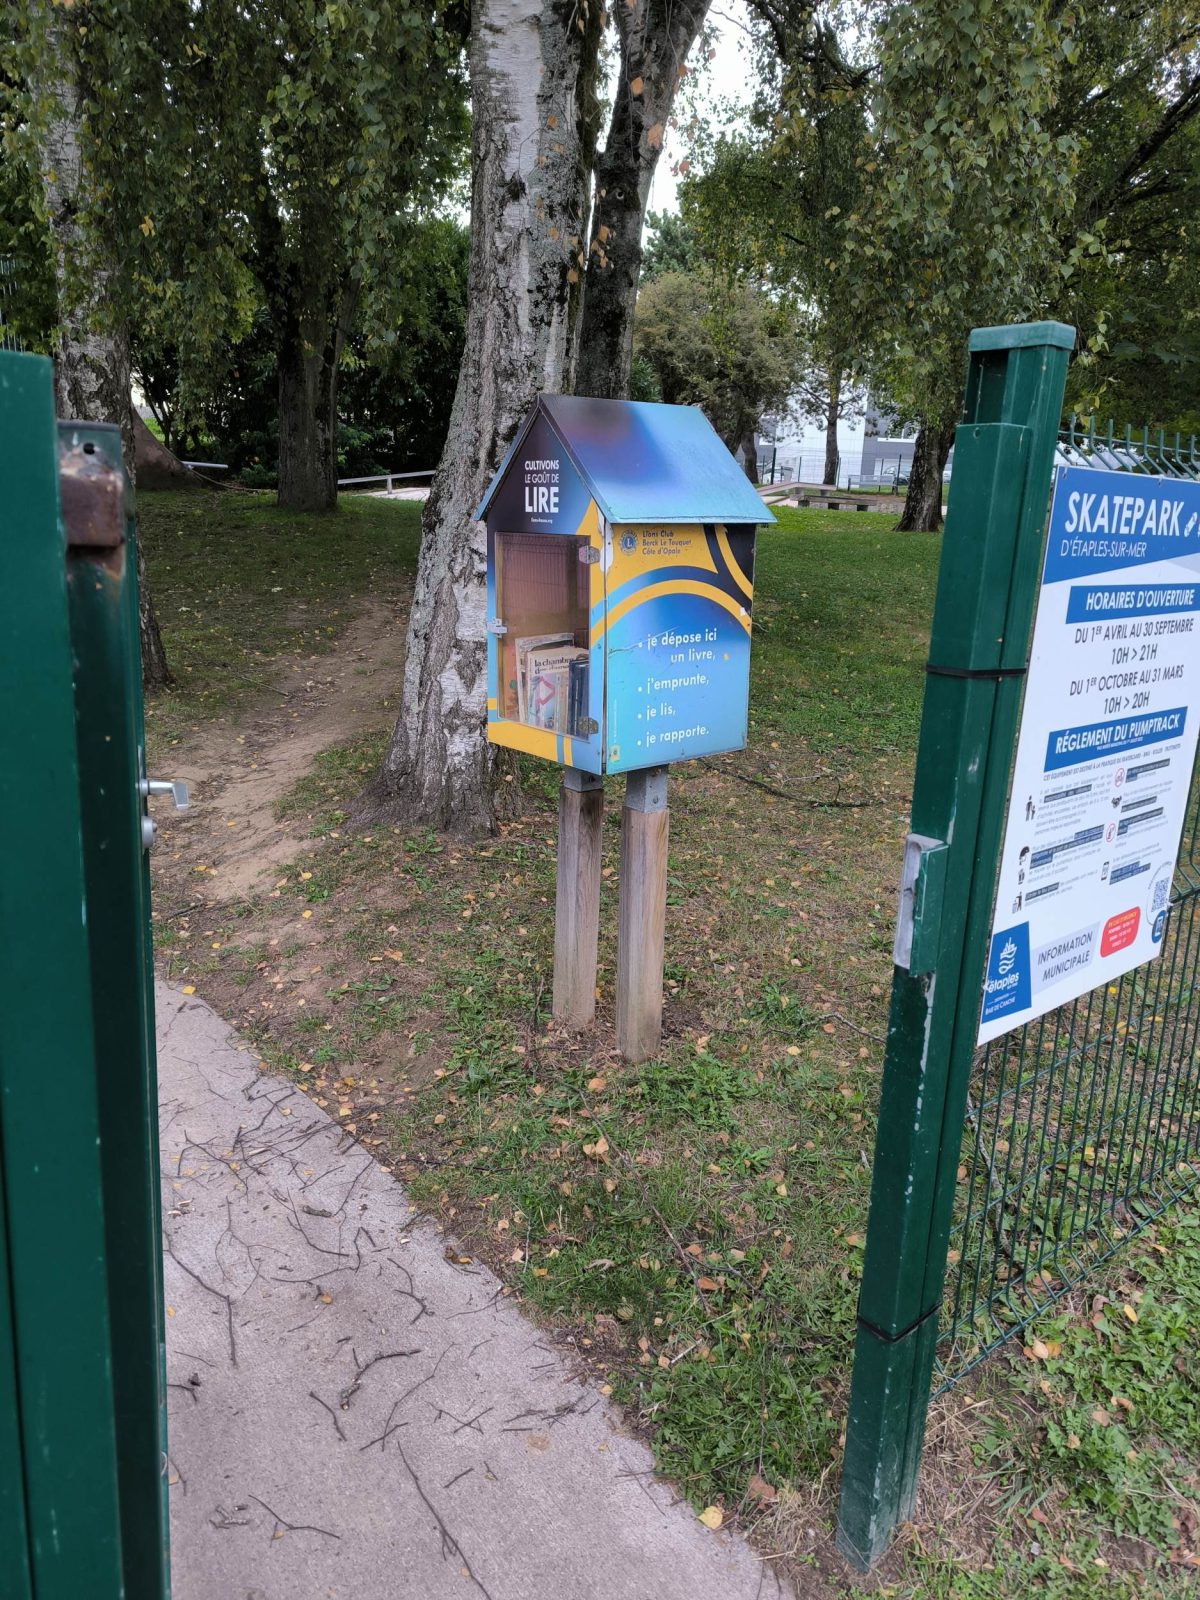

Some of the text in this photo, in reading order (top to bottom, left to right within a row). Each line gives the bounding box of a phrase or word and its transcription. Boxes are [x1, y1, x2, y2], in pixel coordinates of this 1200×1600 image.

[524, 459, 560, 470] CULTIVONS
[524, 471, 560, 484] LE GOÛT DE
[525, 486, 559, 513] LIRE
[1064, 490, 1185, 537] SKATEPARK
[642, 530, 674, 538] Lions Club
[669, 539, 692, 547] Touquet
[642, 547, 681, 555] Côte d'Opale
[1060, 536, 1148, 559] D'ÉTAPLES-SUR-MER
[1085, 588, 1195, 611] HORAIRES D'OUVERTURE
[647, 628, 717, 650] je dépose ici
[1074, 627, 1087, 644] DU
[1103, 624, 1128, 641] AVRIL
[1129, 622, 1143, 638] AU
[1143, 620, 1154, 637] 30
[1154, 618, 1194, 636] SEPTEMBRE
[671, 648, 716, 663] un livre,
[1111, 648, 1129, 665] 10H
[1140, 644, 1158, 662] 21H
[647, 673, 710, 694] j'emprunte,
[1070, 681, 1083, 696] DU
[1098, 673, 1138, 692] OCTOBRE
[1139, 670, 1152, 686] AU
[1152, 668, 1162, 684] 31
[1162, 664, 1184, 681] MARS
[646, 703, 676, 720] je lis,
[1104, 698, 1122, 715] 10H
[1132, 691, 1150, 709] 20H
[646, 724, 710, 748] je rapporte.
[1055, 726, 1114, 754] RÉGLEMENT
[1114, 724, 1129, 742] DU
[1129, 713, 1180, 740] PUMPTRACK
[1038, 931, 1094, 966] INFORMATION
[1042, 950, 1090, 982] MUNICIPALE
